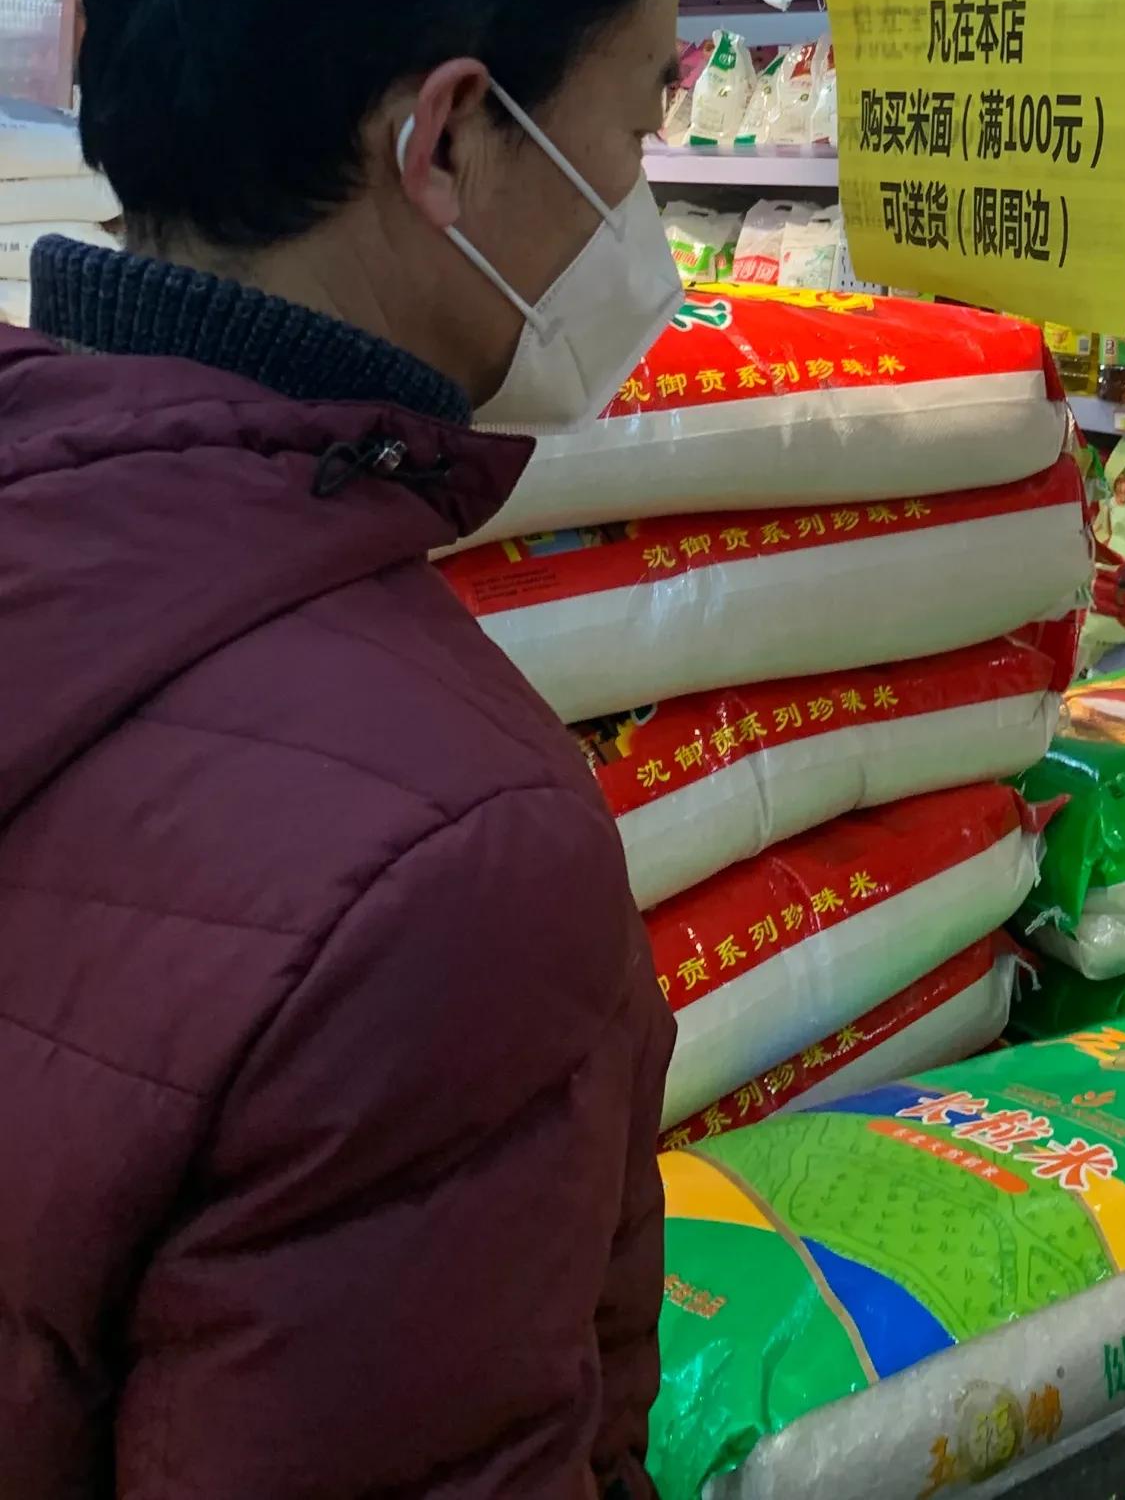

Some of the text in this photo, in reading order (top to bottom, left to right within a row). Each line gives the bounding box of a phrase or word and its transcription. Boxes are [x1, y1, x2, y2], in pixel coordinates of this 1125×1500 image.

[859, 88, 1104, 169] 购买米面（满100元）
[880, 181, 1069, 268] 可送货（限周边）
[636, 685, 899, 789] 沈御贡系列珍珠米
